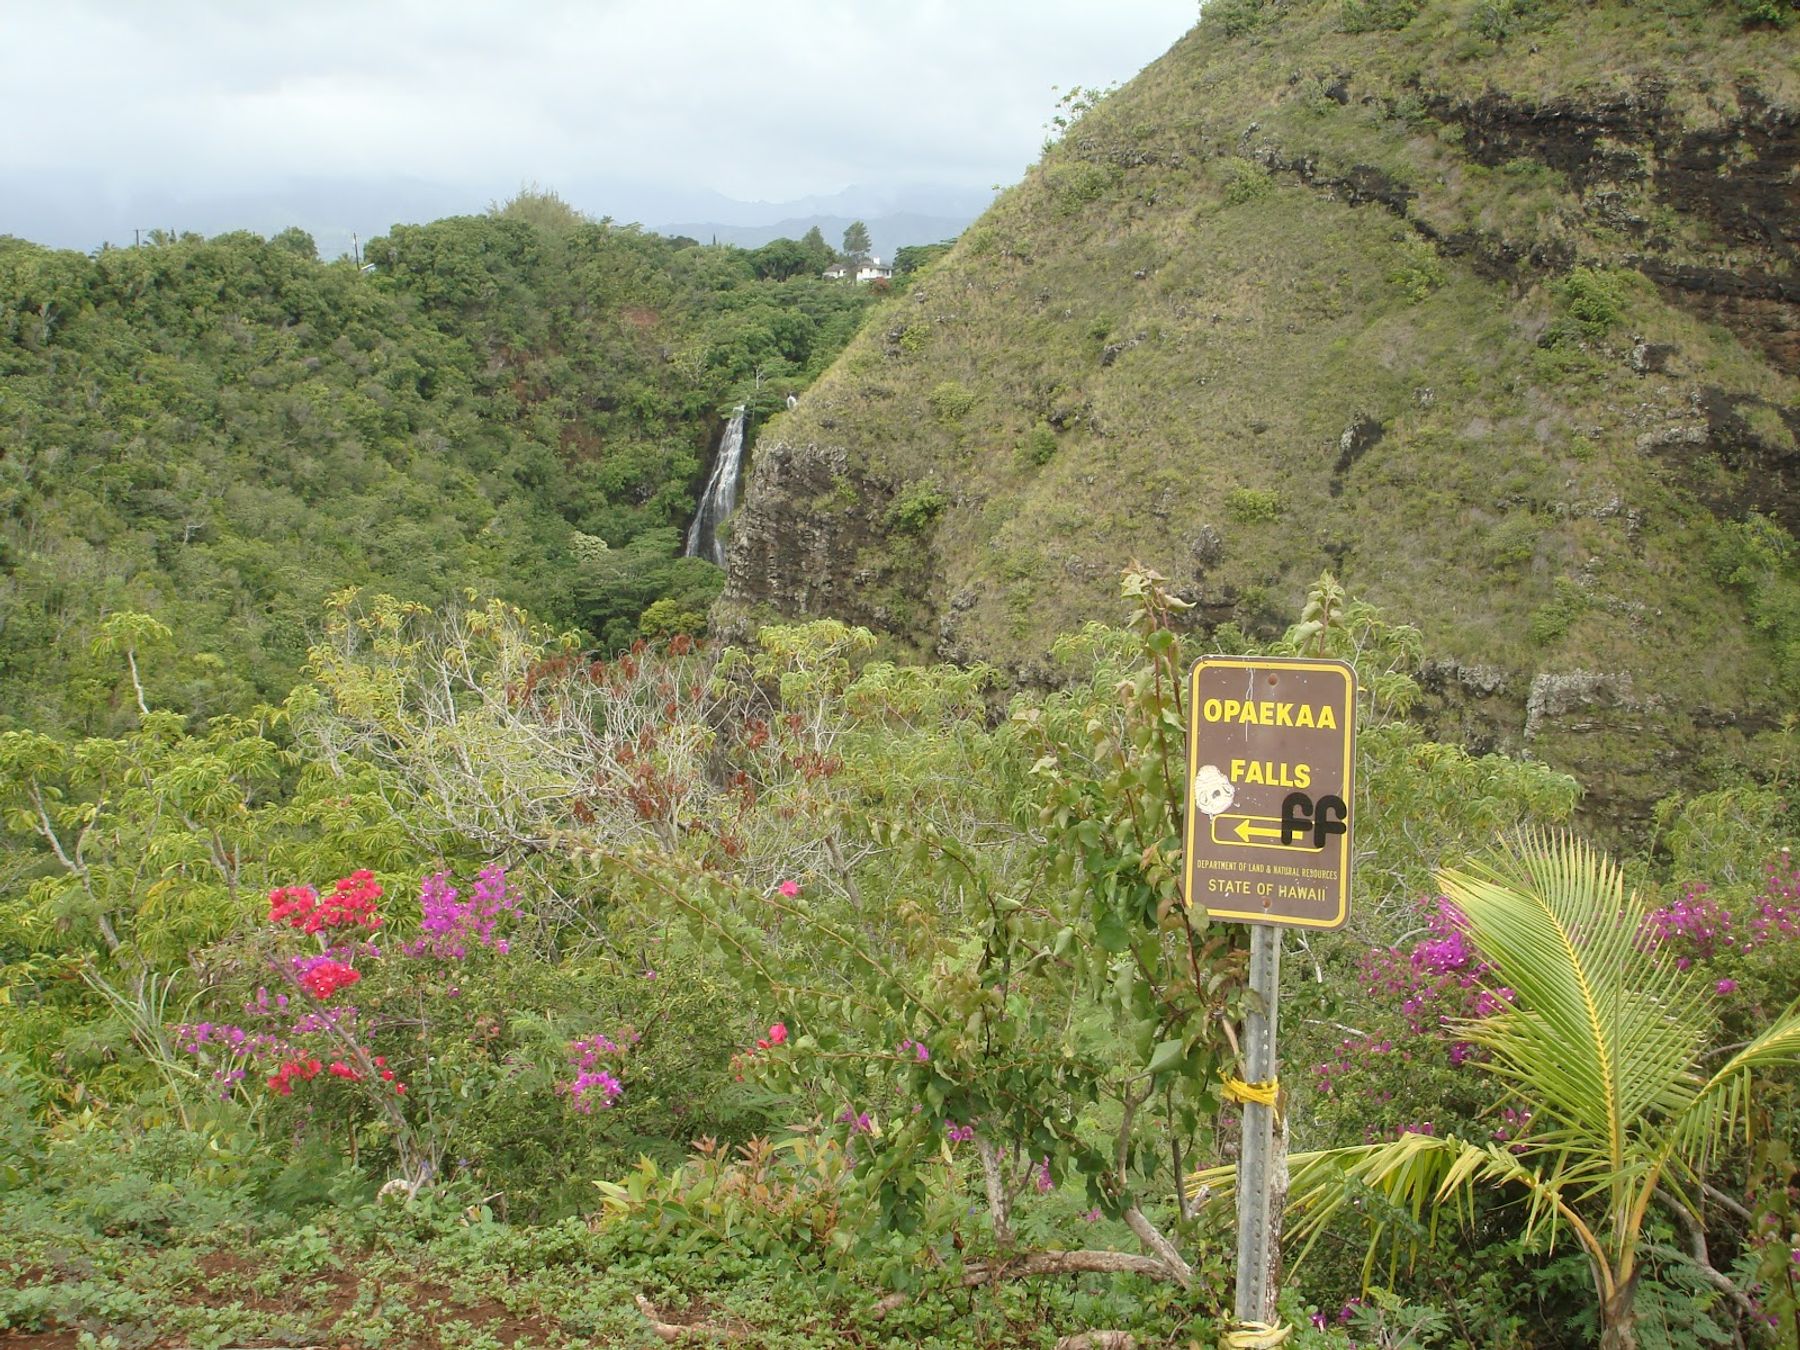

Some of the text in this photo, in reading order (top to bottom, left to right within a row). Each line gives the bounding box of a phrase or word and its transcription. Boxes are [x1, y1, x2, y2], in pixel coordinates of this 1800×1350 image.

[1203, 698, 1337, 730] OPAEKAA
[1230, 759, 1311, 789] FALLS
[1197, 859, 1338, 880] DEPARTMENT OF LAND & NATURAL RESOURCES
[1208, 879, 1326, 902] STATE OF HAWAII
